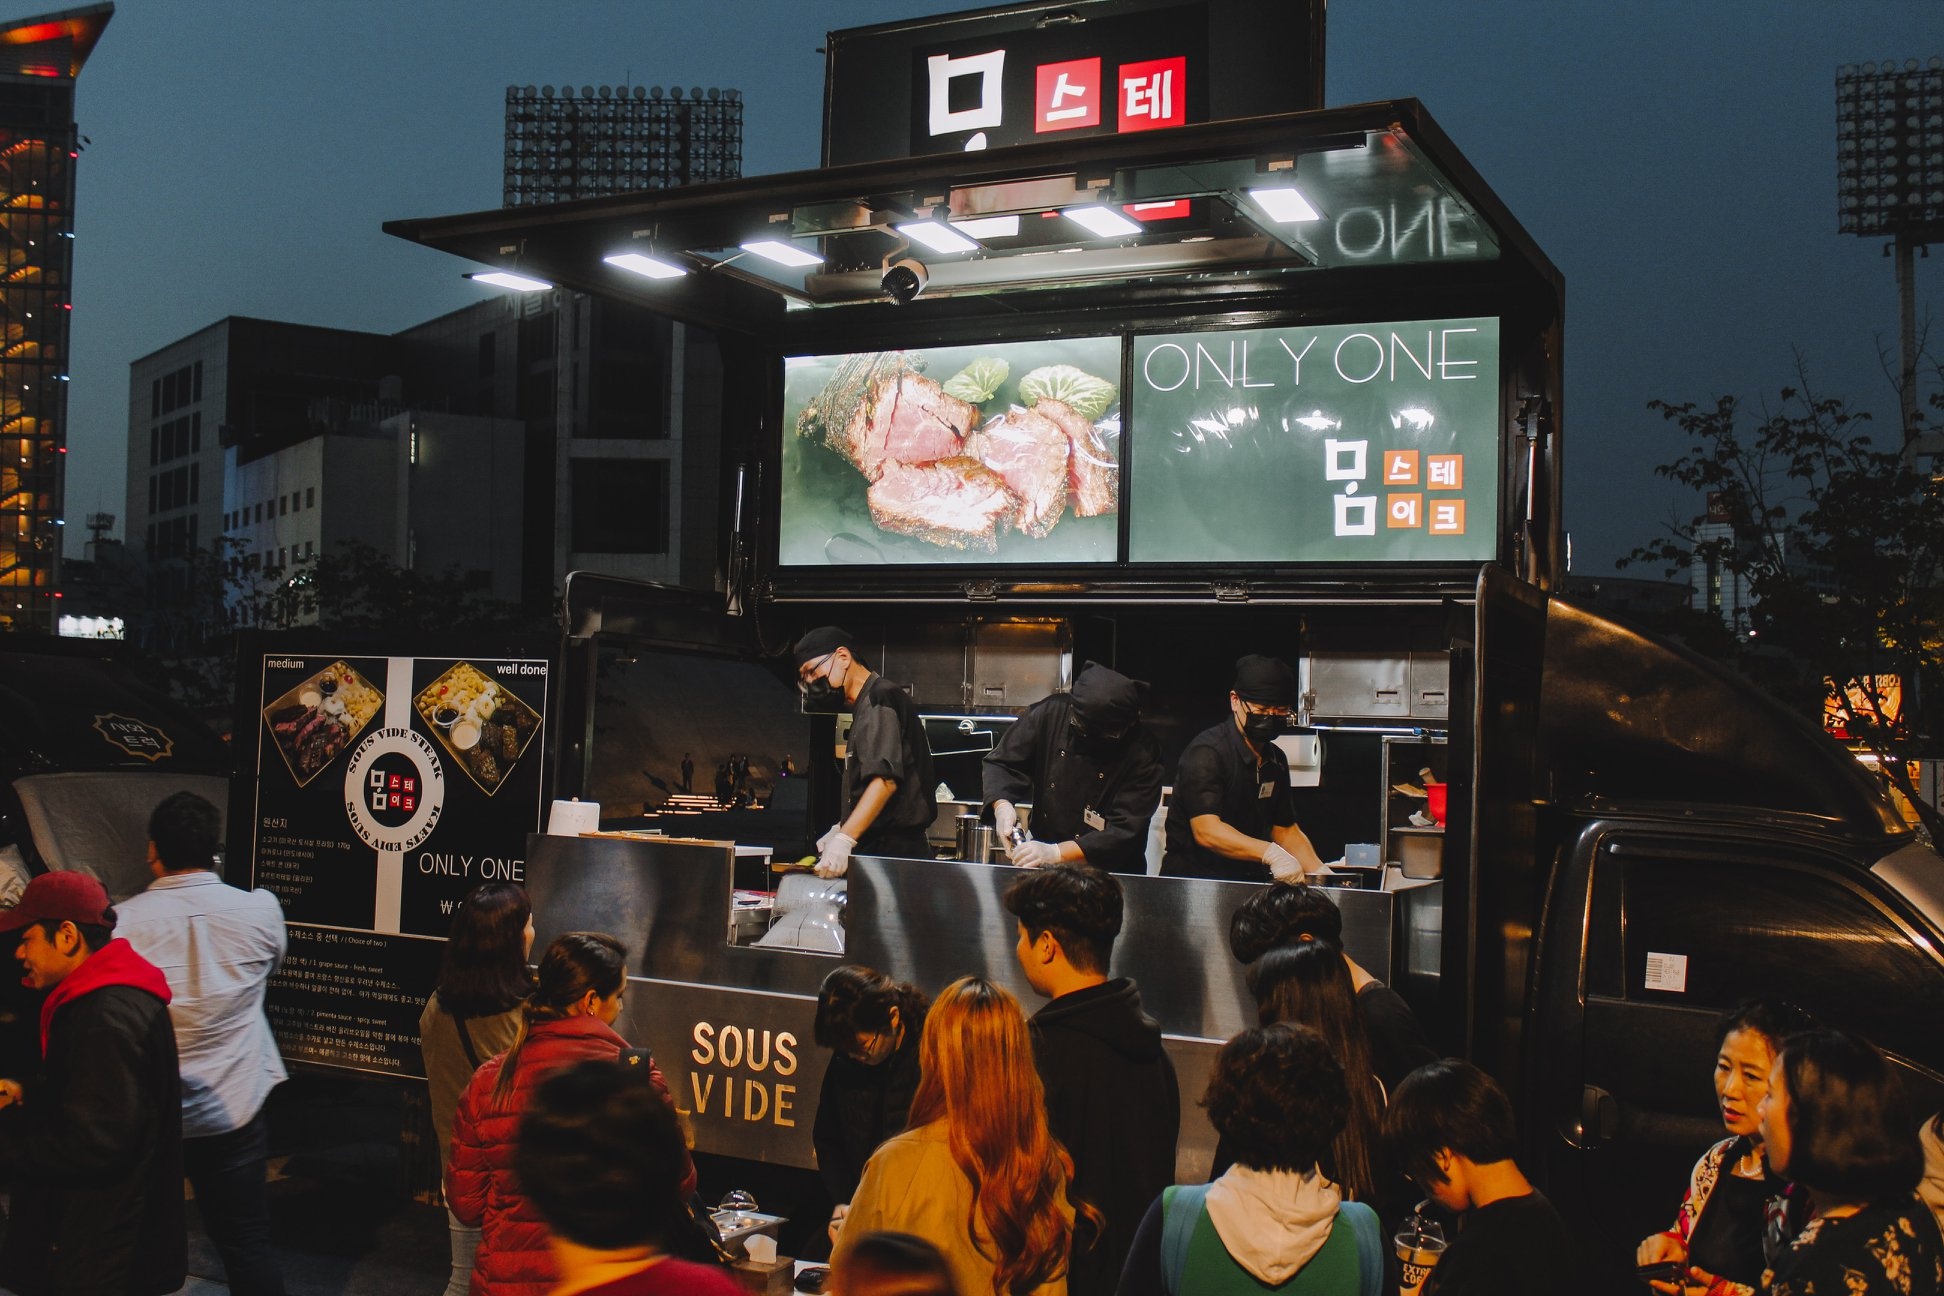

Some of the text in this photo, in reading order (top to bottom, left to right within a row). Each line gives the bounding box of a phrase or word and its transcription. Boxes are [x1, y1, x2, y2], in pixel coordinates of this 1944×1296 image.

[1144, 328, 1478, 391] ONLY ONE
[268, 659, 304, 669] medium
[497, 663, 547, 676] well done
[348, 727, 443, 780] SOUS VIDE STEAK
[263, 817, 288, 828] 원산지
[419, 852, 525, 882] ONLY ONE
[288, 929, 313, 940] 수제소스
[316, 932, 323, 942] 중
[325, 934, 338, 943] 선택
[348, 937, 366, 945] Choice
[692, 1021, 798, 1076] SOUS
[690, 1071, 796, 1128] VIDE
